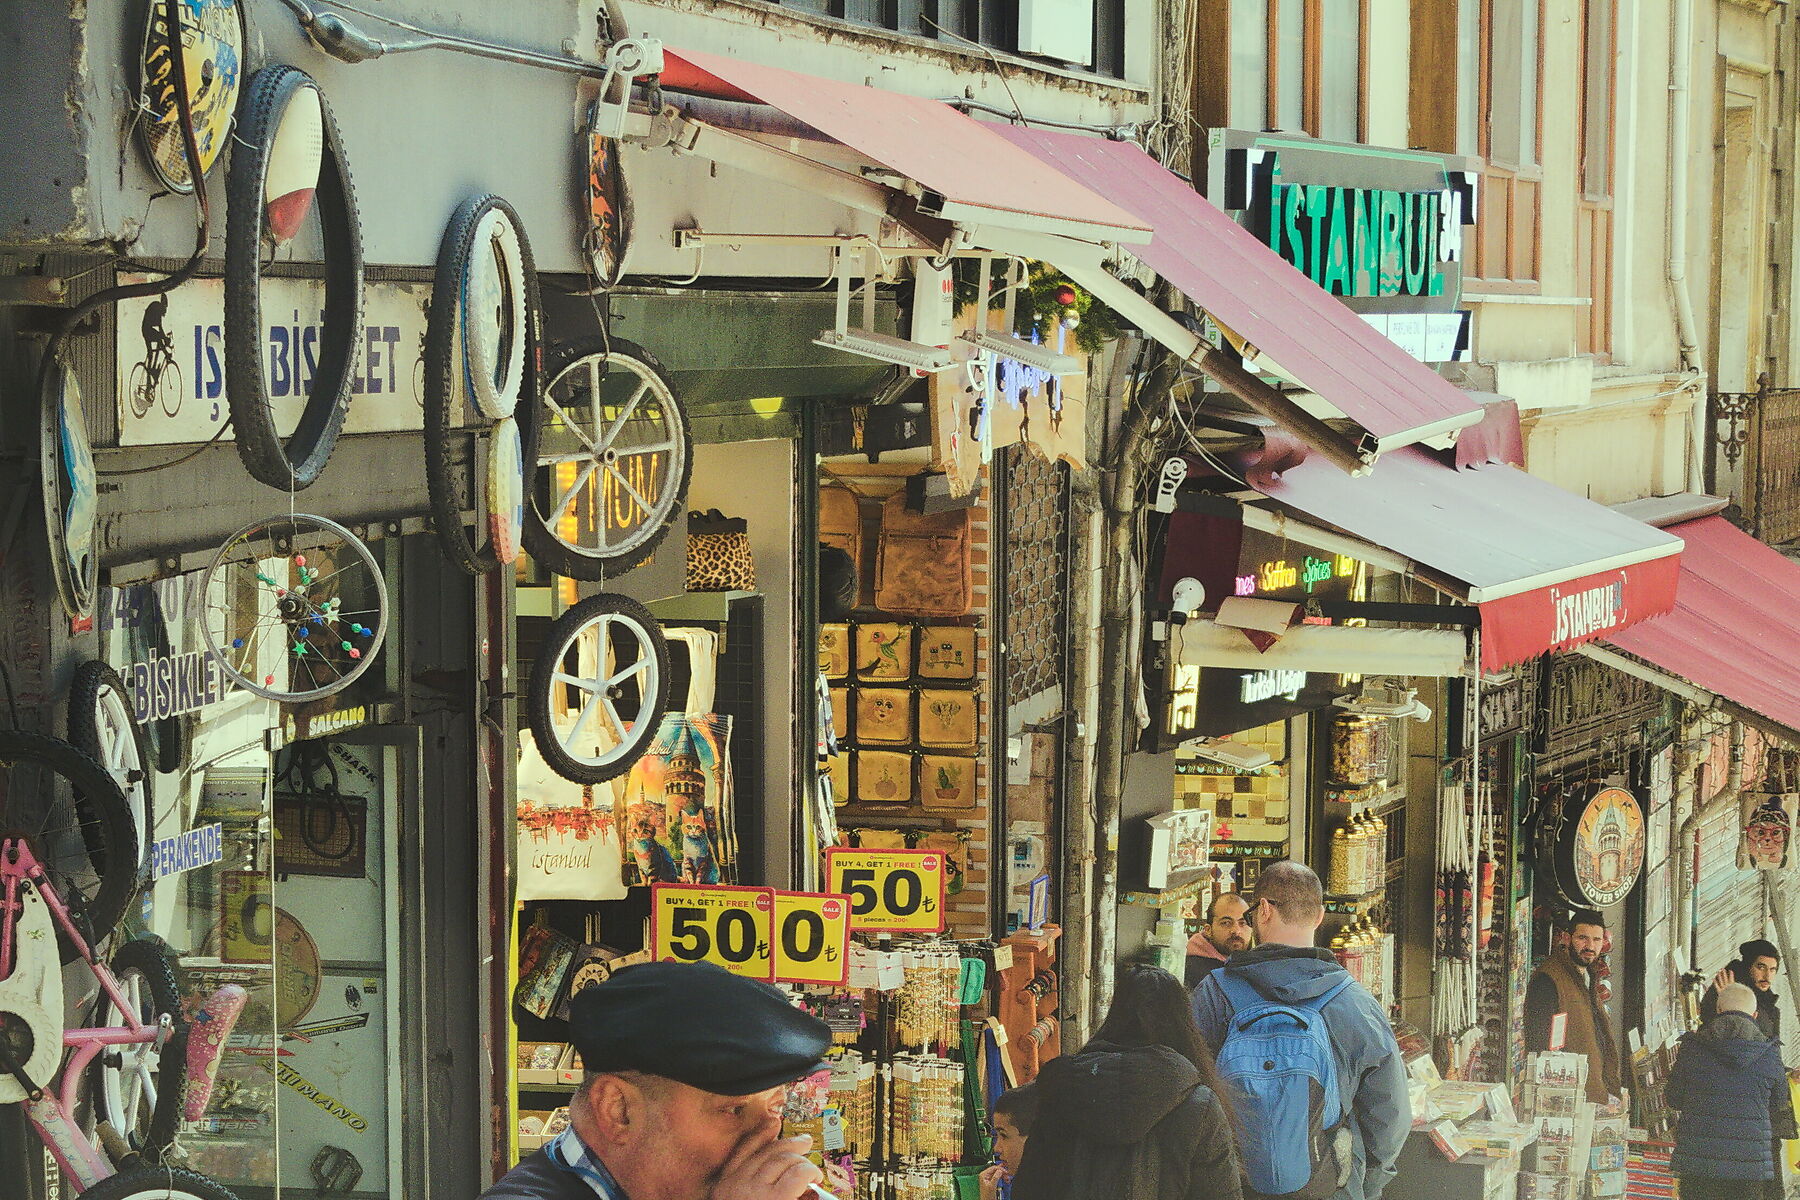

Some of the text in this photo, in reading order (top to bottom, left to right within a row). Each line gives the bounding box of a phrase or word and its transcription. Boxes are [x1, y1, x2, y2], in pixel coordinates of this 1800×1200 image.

[1440, 189, 1462, 263] 34
[1261, 560, 1297, 591] Saffron
[1303, 555, 1332, 593] Spices
[134, 644, 229, 725] BİSİKLET
[309, 705, 366, 736] SALCANO
[333, 745, 378, 783] SHARK
[152, 822, 223, 881] PERAKENDE
[532, 846, 593, 875] istanbul
[836, 860, 854, 868] BUY
[855, 860, 865, 869] 4,
[893, 861, 916, 869] FREE
[665, 897, 685, 906] BUY
[686, 898, 696, 907] 4,
[697, 898, 716, 907] GET
[717, 898, 724, 907] 1
[726, 900, 750, 909] FREE
[1583, 875, 1634, 903] TOWER SHOP
[822, 906, 841, 914] SALE
[262, 1058, 368, 1132] SHIMANO
